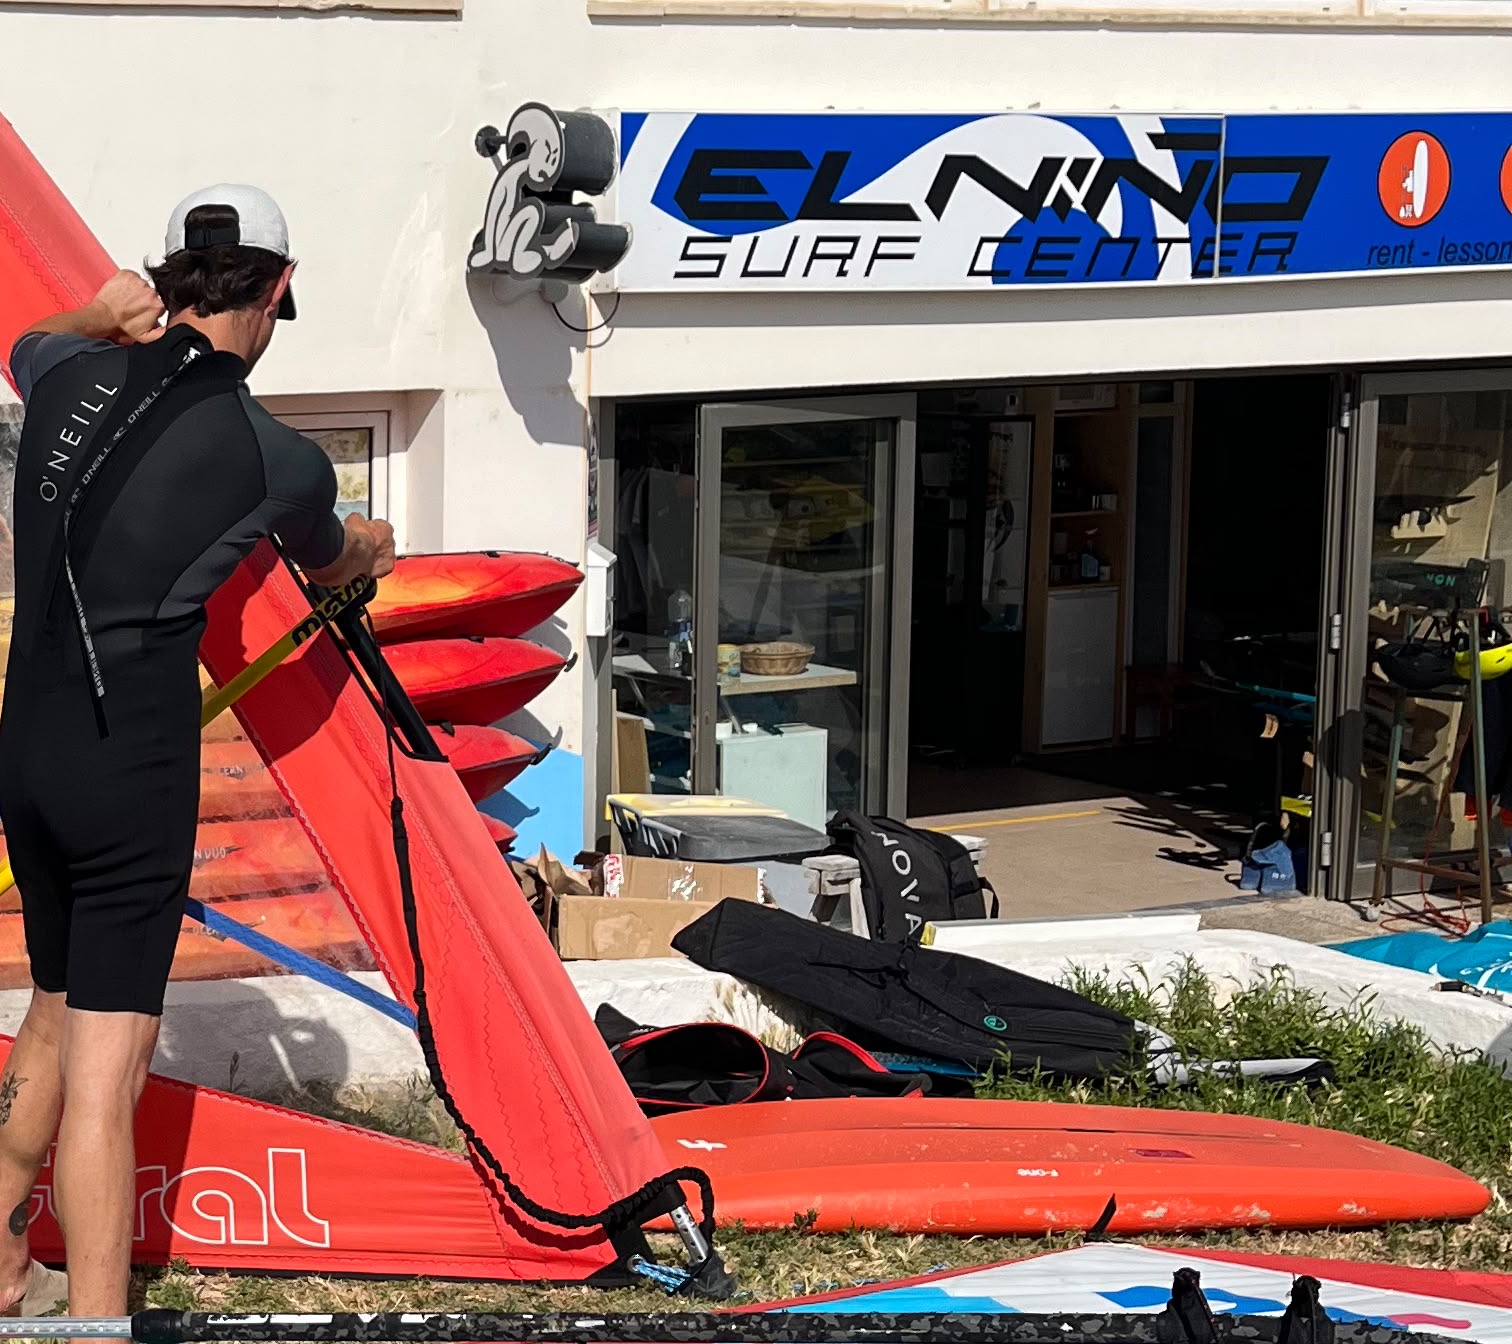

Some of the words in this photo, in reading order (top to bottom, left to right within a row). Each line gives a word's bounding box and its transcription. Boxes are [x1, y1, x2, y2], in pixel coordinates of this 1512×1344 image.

[673, 235, 921, 279] SURF
[966, 232, 1299, 280] CENTER
[1366, 239, 1416, 266] rent
[39, 384, 118, 503] O'NEILL
